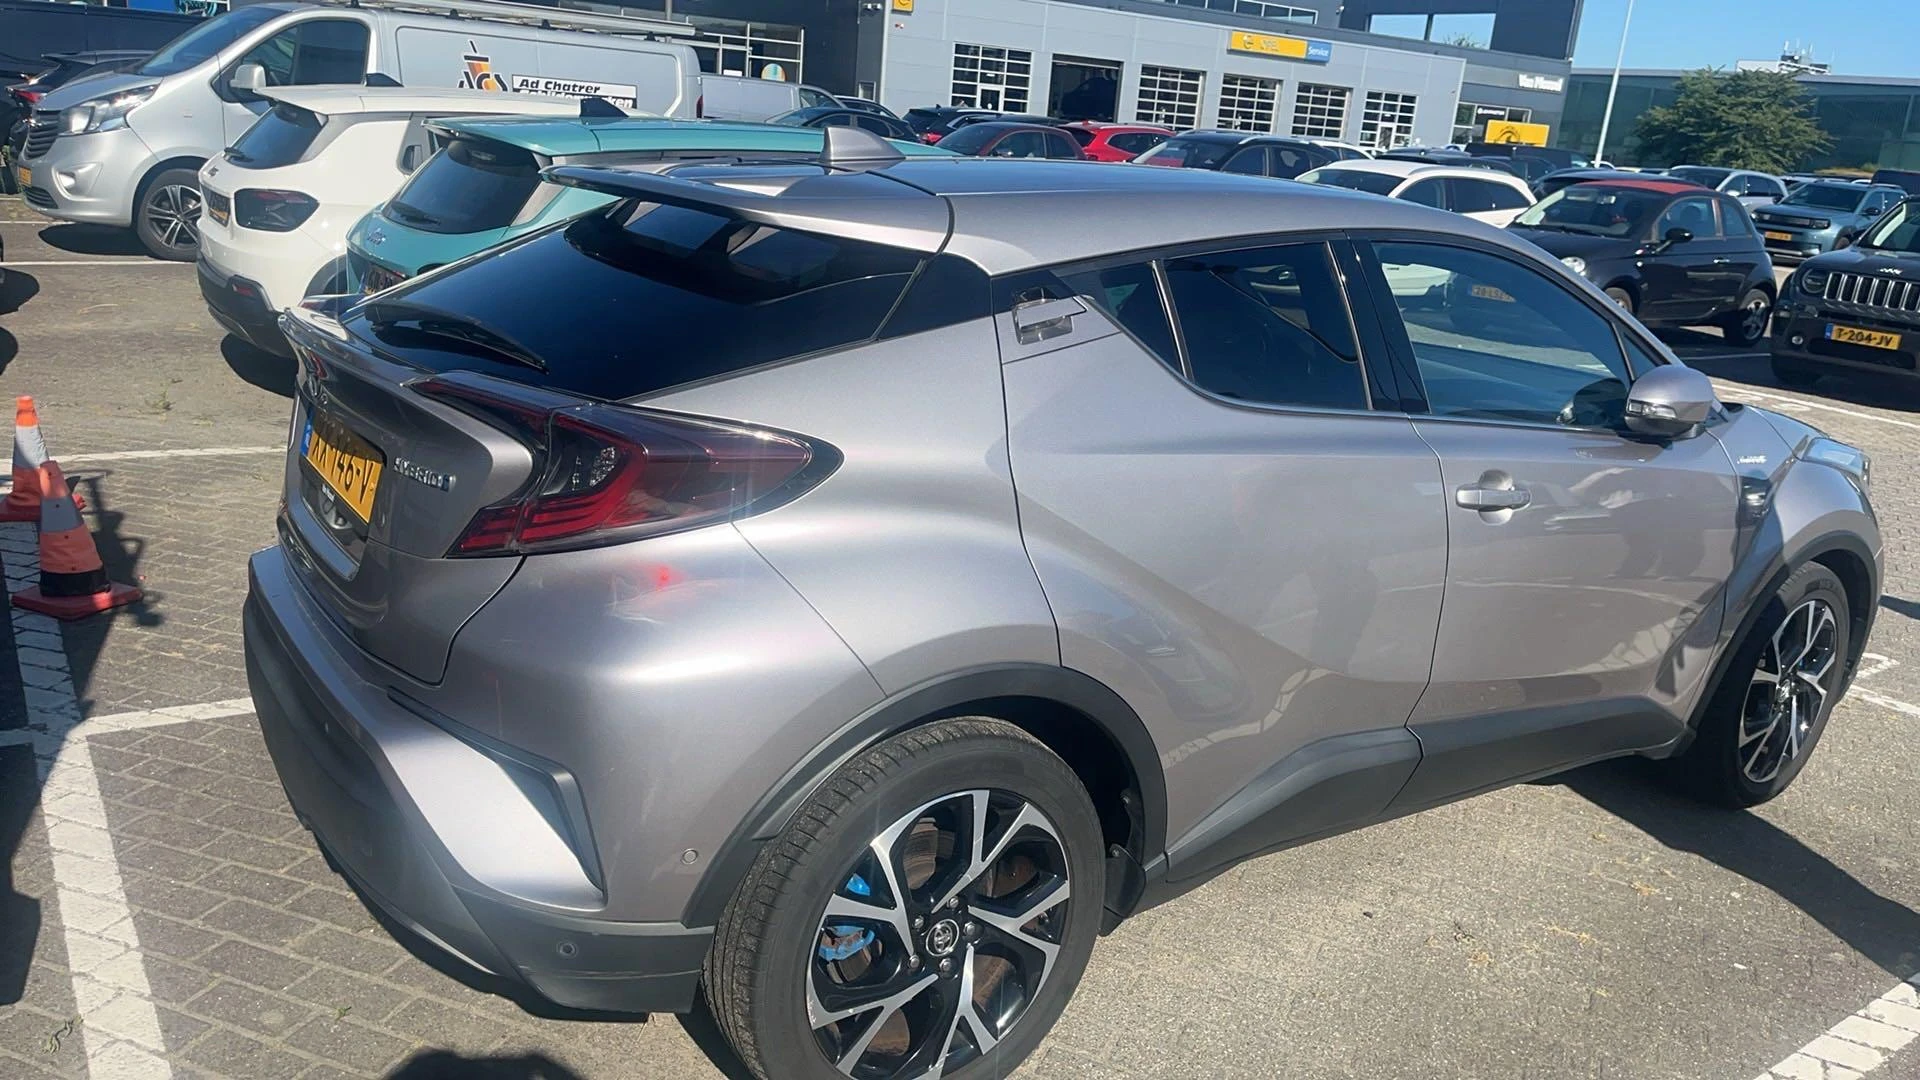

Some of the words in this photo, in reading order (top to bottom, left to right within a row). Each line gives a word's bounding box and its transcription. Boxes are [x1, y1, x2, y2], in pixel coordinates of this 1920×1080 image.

[1308, 46, 1329, 57] Service
[519, 79, 540, 89] Ad
[544, 81, 601, 94] Chatrer
